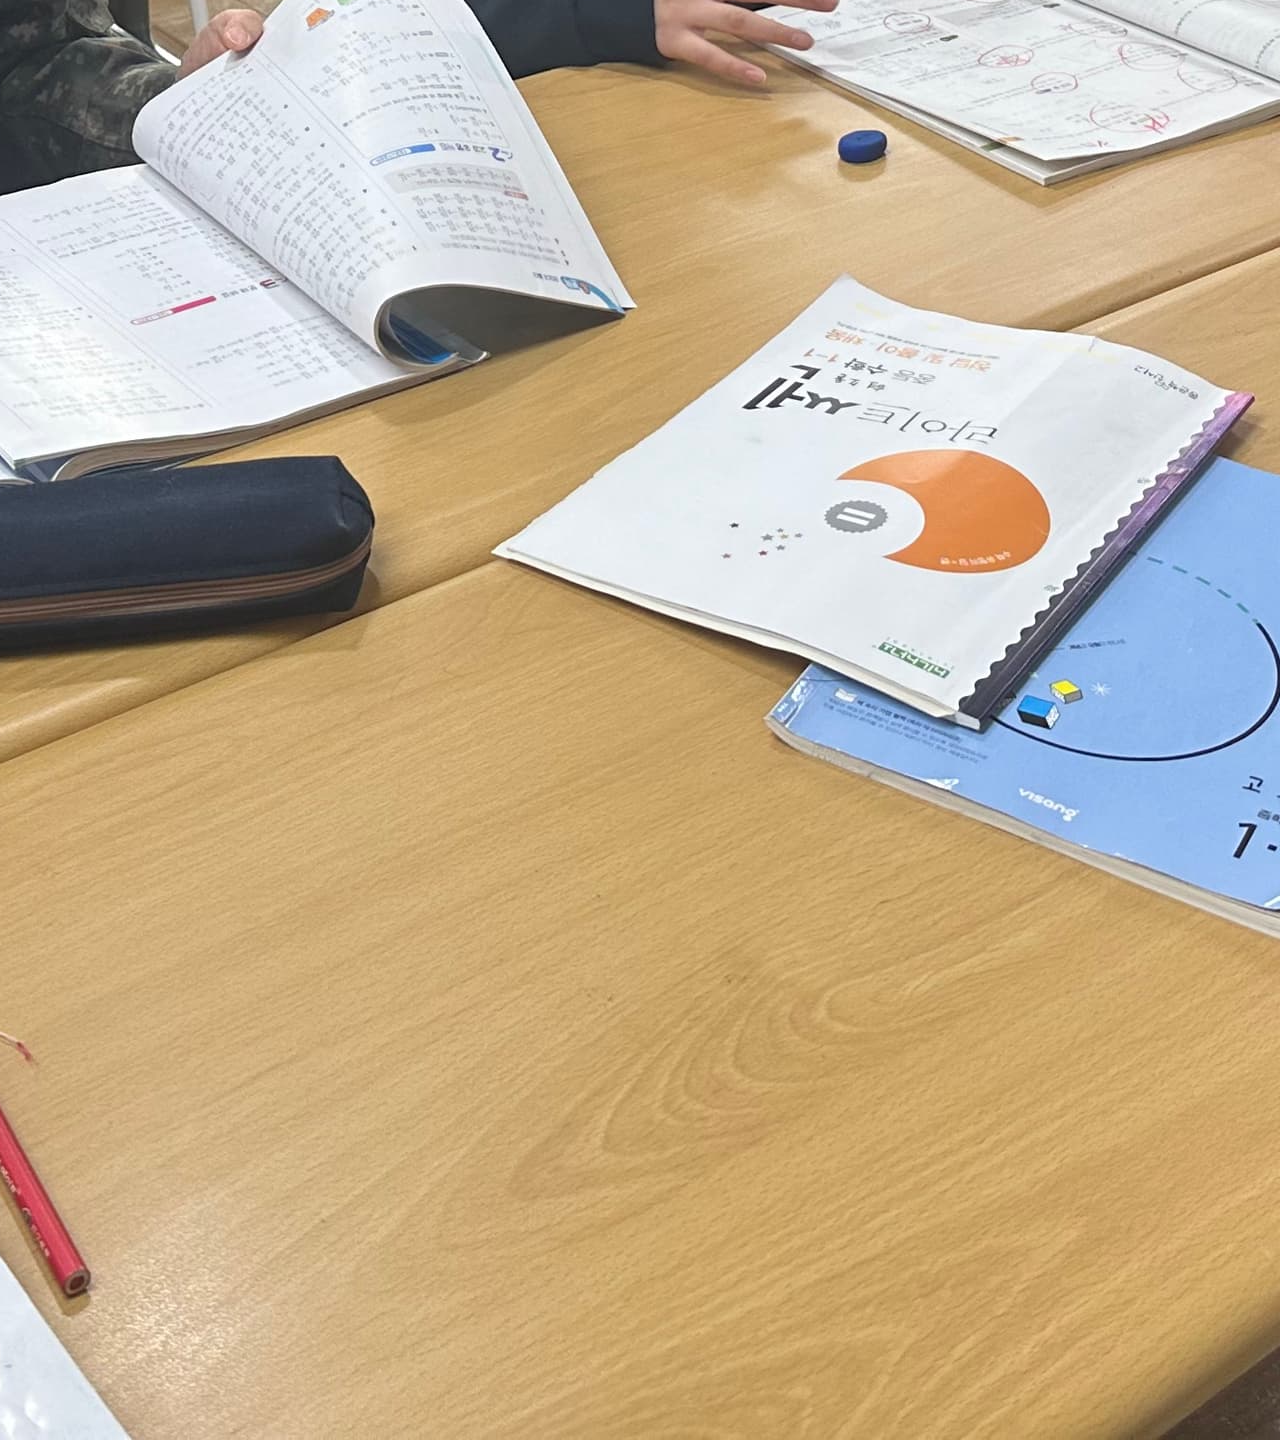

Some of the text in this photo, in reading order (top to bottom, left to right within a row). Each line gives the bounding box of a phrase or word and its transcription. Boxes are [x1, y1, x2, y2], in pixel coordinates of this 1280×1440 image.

[844, 358, 888, 375] 수학
[892, 369, 936, 385] 중등
[1019, 787, 1077, 822] visang
